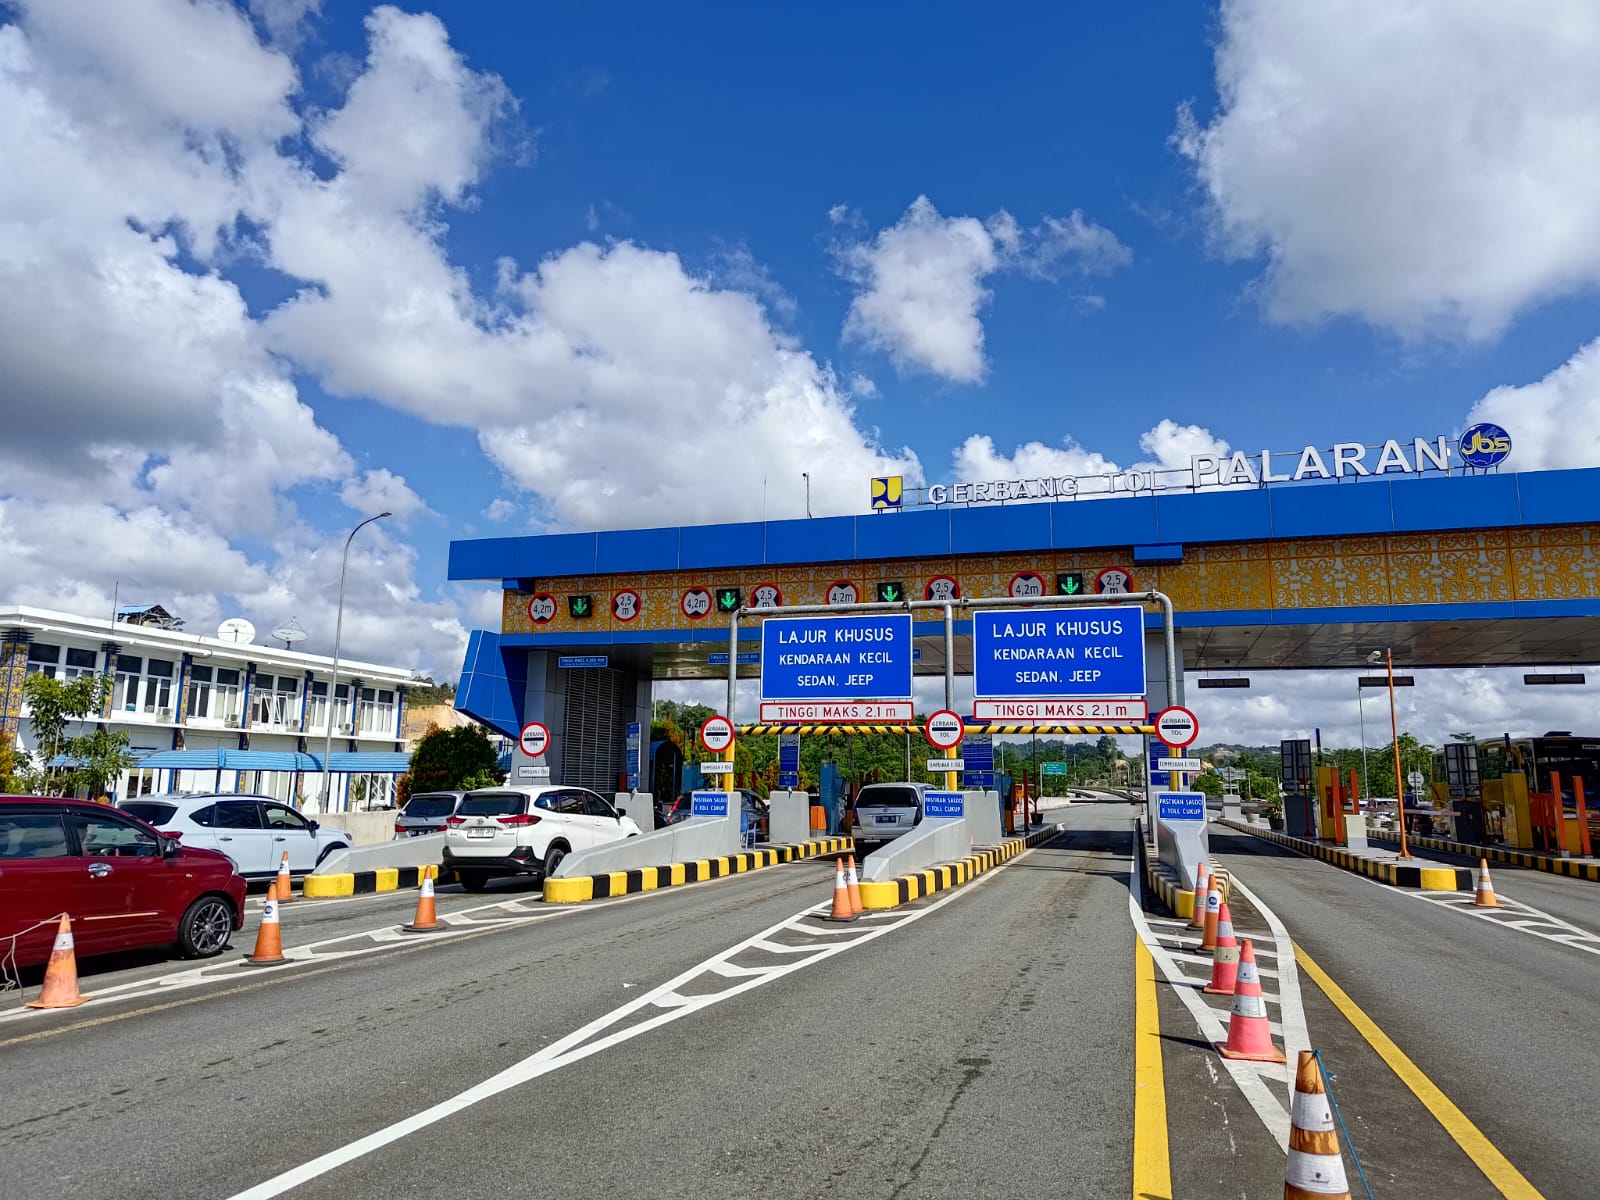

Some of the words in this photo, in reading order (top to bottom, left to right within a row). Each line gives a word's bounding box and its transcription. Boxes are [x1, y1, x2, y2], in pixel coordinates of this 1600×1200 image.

[928, 474, 1079, 504] GERBANG
[1102, 469, 1167, 492] TOL
[1191, 435, 1450, 487] PALARAN
[1106, 574, 1121, 586] 2,5
[935, 582, 949, 593] 2,5
[1015, 584, 1039, 596] 4,2m
[620, 596, 632, 607] 2,5
[686, 598, 707, 610] 4,2m
[832, 592, 853, 604] 4,2m
[533, 604, 552, 616] 4,2m
[621, 607, 630, 615] m
[993, 623, 1046, 638] LAJUR
[1056, 620, 1123, 636] KHUSUS
[779, 630, 827, 644] LAJUR
[835, 628, 894, 642] KHUSUS
[779, 653, 850, 665] KENDARAAN
[859, 652, 893, 664] KECIL
[994, 648, 1075, 660] KENDARAAN
[1084, 646, 1123, 659] KECIL
[845, 674, 874, 686] JEEP
[1068, 670, 1102, 682] JEEP
[778, 707, 818, 718] TINGGI
[886, 707, 896, 718] m
[994, 705, 1038, 716] TINGGI
[1115, 705, 1127, 716] m
